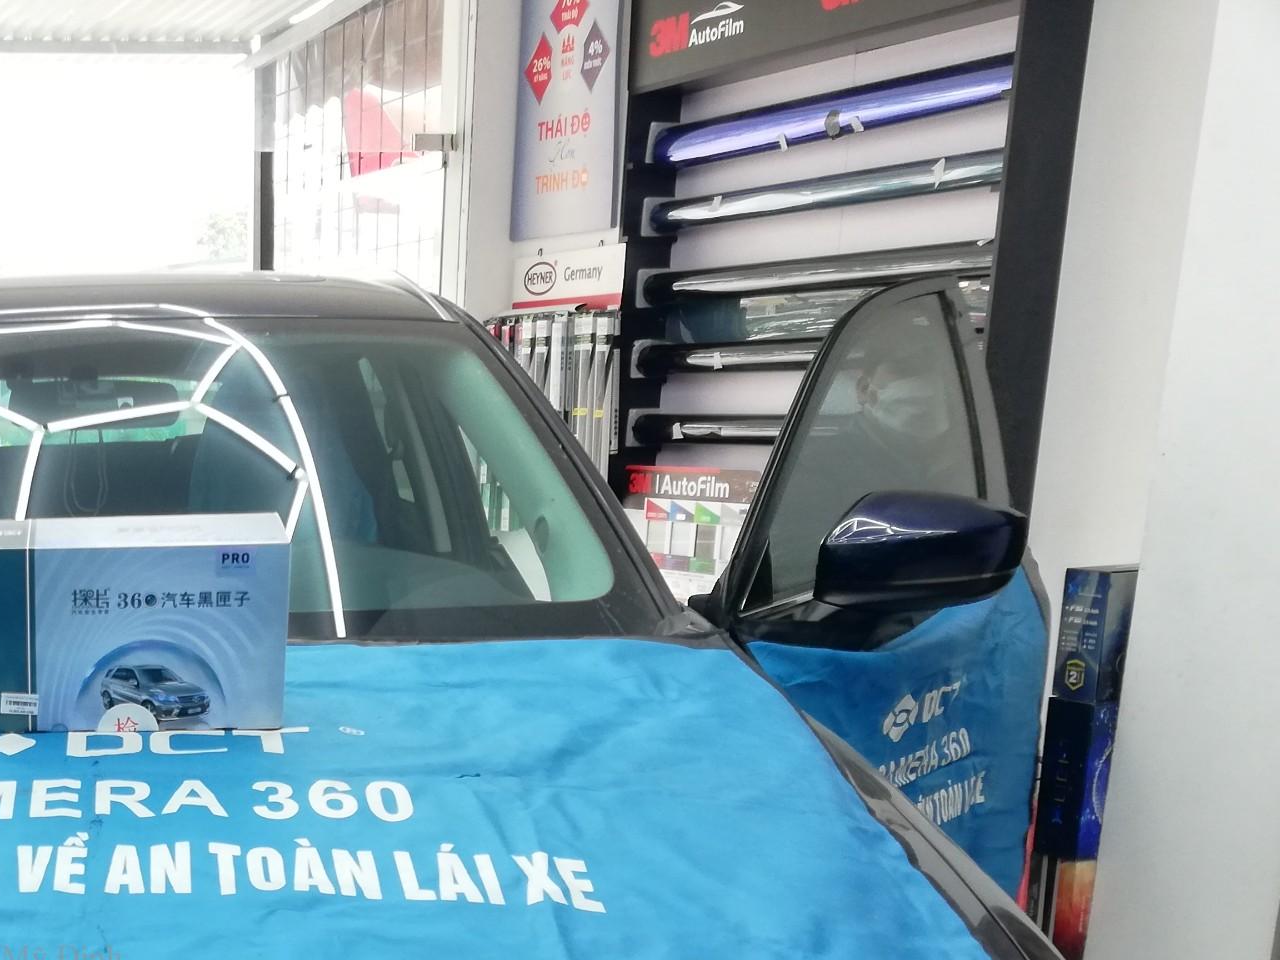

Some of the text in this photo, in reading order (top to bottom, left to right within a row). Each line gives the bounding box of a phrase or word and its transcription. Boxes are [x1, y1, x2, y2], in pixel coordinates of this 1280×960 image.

[588, 39, 603, 56] 4%
[649, 11, 744, 58] 3M AutoFilm
[532, 56, 551, 73] 26%
[538, 114, 568, 141] THÁI
[526, 266, 603, 286] HEYNER Germany
[660, 474, 730, 498] AutoFilm
[221, 552, 250, 565] PRO
[66, 726, 310, 758] DCT
[940, 727, 972, 767] 360
[252, 779, 415, 823] 360
[16, 831, 89, 896] VỀ
[104, 840, 193, 896] AN
[208, 837, 384, 901] TOÀN
[393, 842, 507, 906] LÁI
[511, 850, 608, 914] XE
